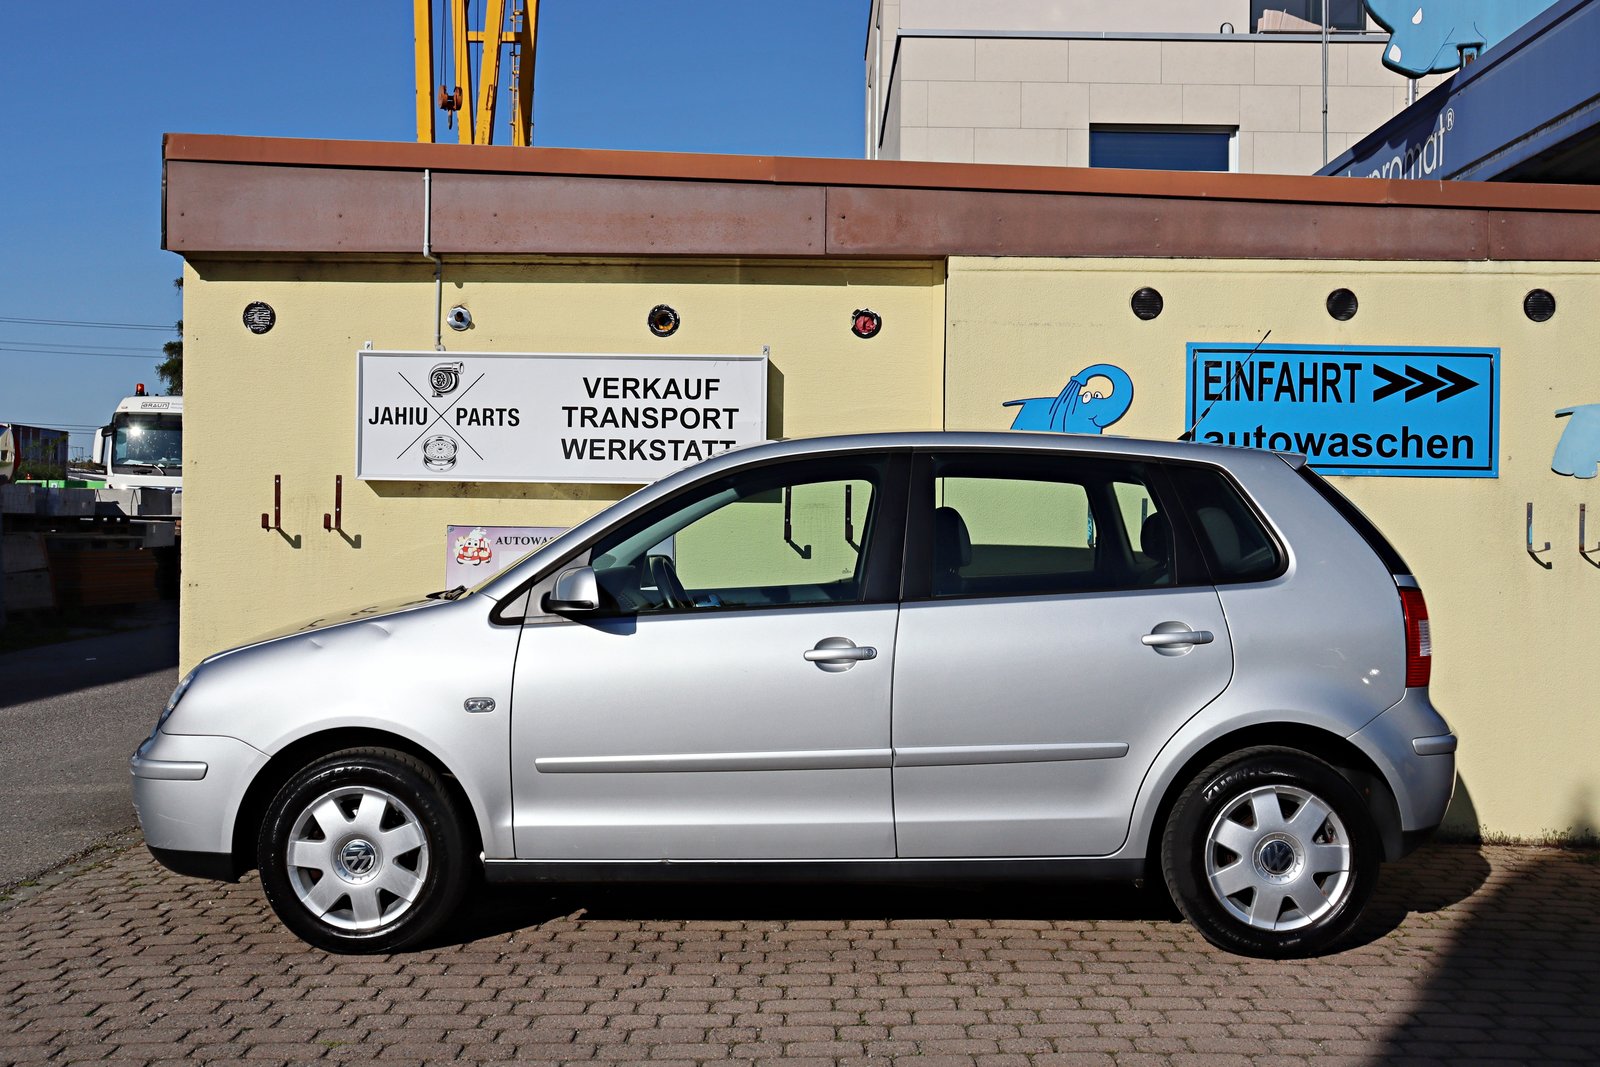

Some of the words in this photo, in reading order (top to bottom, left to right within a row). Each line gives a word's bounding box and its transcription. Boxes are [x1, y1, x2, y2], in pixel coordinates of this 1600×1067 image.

[582, 377, 721, 400] VERKAUF
[1204, 360, 1363, 404] EINFAHRT
[368, 406, 428, 426] JAHIU
[455, 407, 520, 427] PARTS
[561, 406, 740, 430] TRANSPORT
